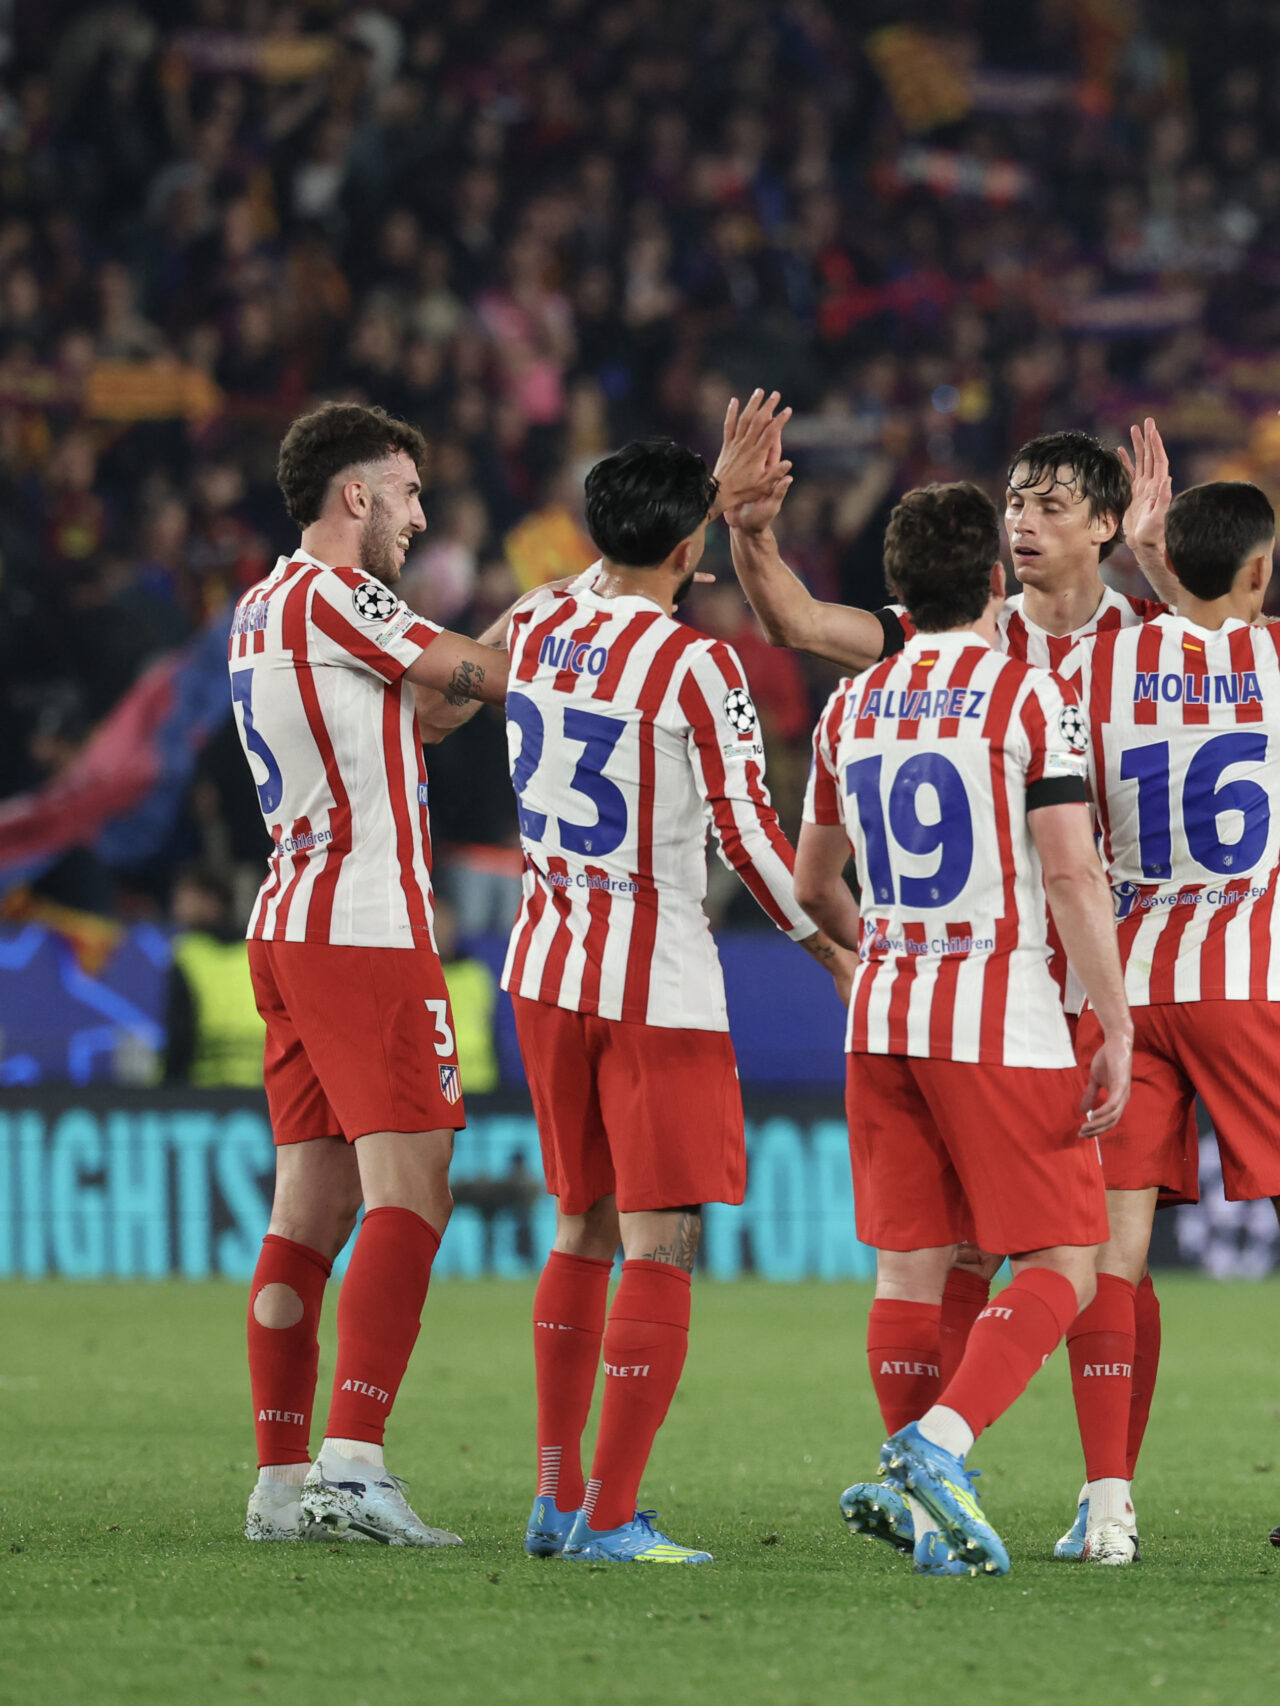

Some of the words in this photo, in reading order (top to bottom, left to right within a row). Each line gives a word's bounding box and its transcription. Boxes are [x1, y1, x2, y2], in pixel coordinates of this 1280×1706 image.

[538, 635, 608, 676] NICO
[1133, 671, 1264, 704] MOLINA
[862, 688, 987, 721] ALVAREZ
[231, 667, 284, 816] 3
[506, 690, 629, 858] 23
[1119, 731, 1272, 881] 16
[284, 829, 334, 852] Children
[845, 751, 975, 909] 19
[576, 873, 639, 893] Children
[931, 936, 994, 955] Children
[424, 999, 455, 1058] 3
[880, 1360, 940, 1378] ATLETI
[1083, 1362, 1132, 1379] ATLETI
[341, 1378, 390, 1404] ATLETI
[258, 1408, 305, 1426] ATLETI
